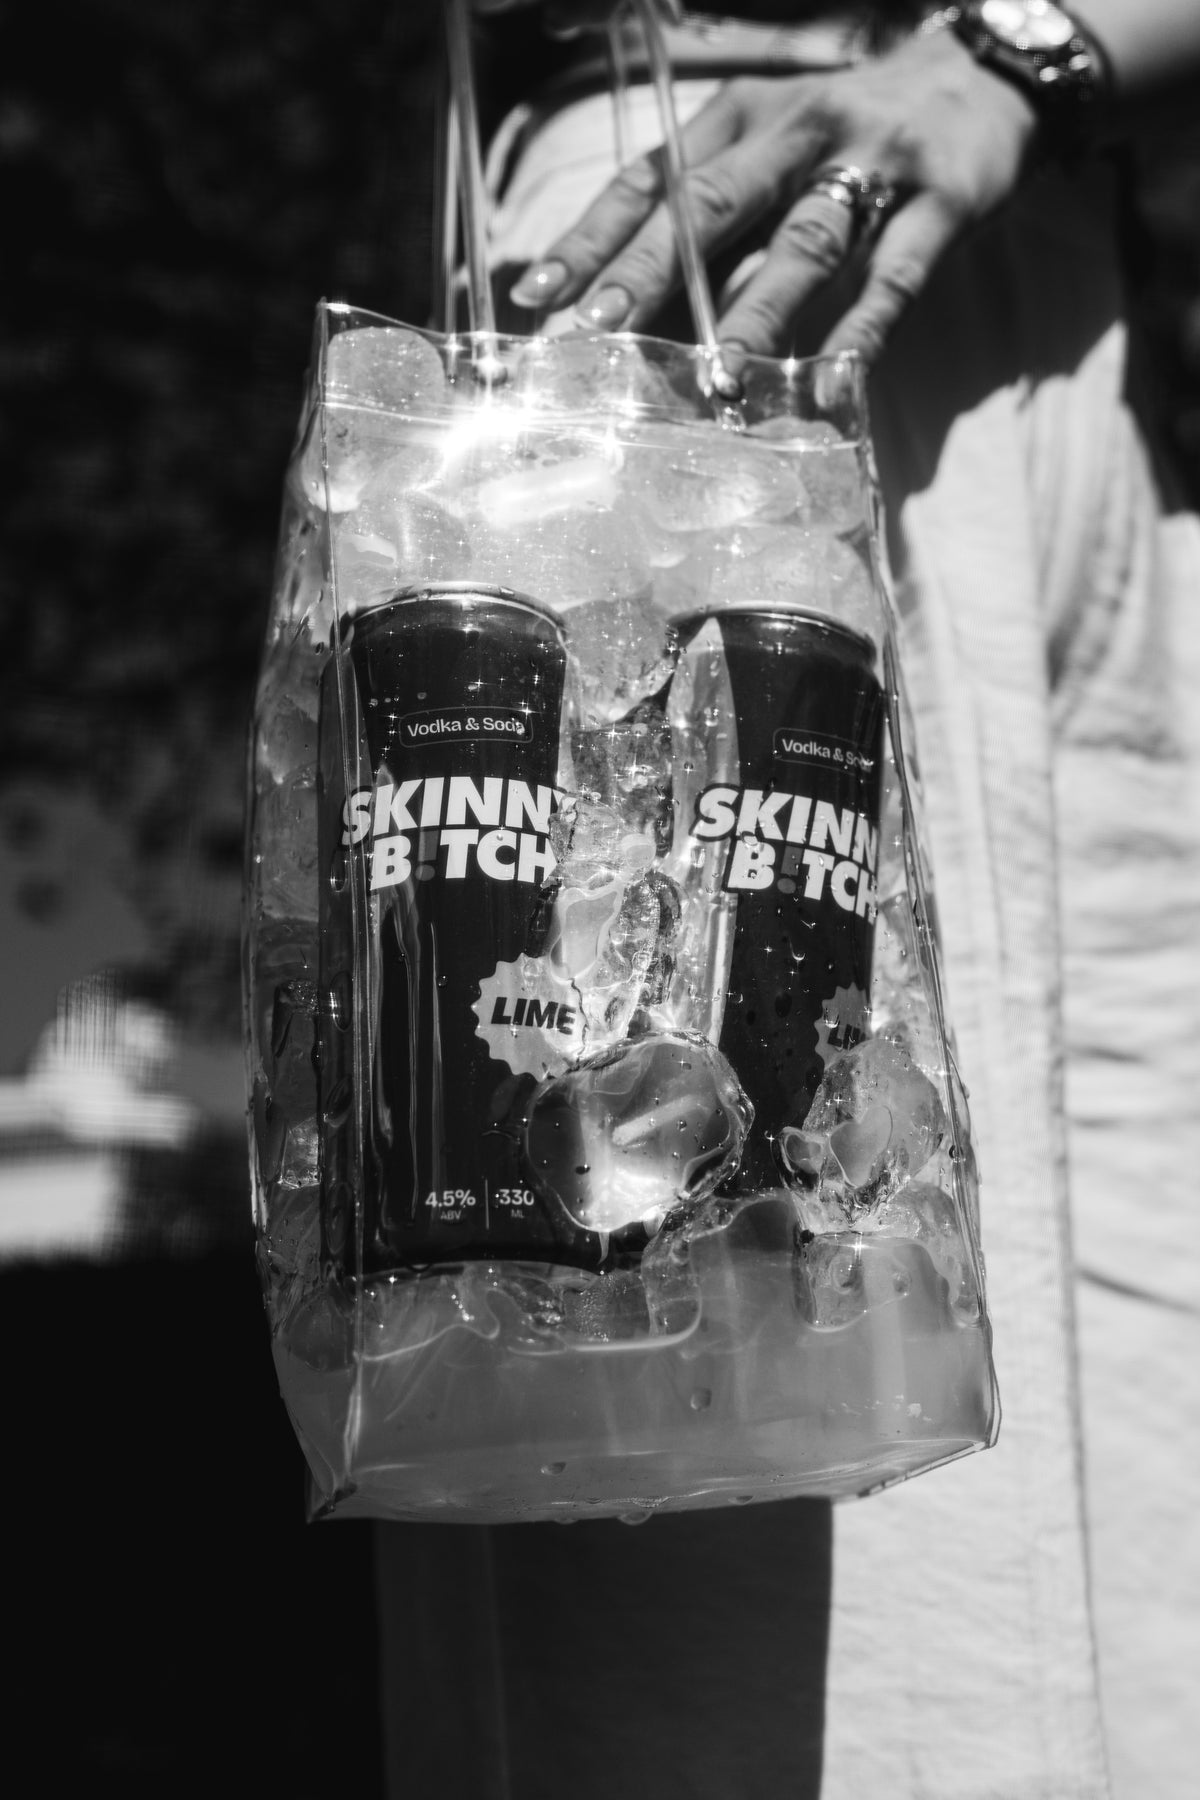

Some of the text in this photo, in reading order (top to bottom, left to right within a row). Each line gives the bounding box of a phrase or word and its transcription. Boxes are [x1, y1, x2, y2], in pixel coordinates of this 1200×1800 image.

[407, 717, 525, 737] Vodka & Soda
[782, 738, 831, 759] Vodka
[832, 747, 844, 762] &
[370, 829, 558, 891] B!TCH
[727, 839, 877, 926] B!TCH
[490, 996, 577, 1035] LIME
[425, 1189, 535, 1208] 4.5% 330
[440, 1209, 525, 1220] ABV ML
